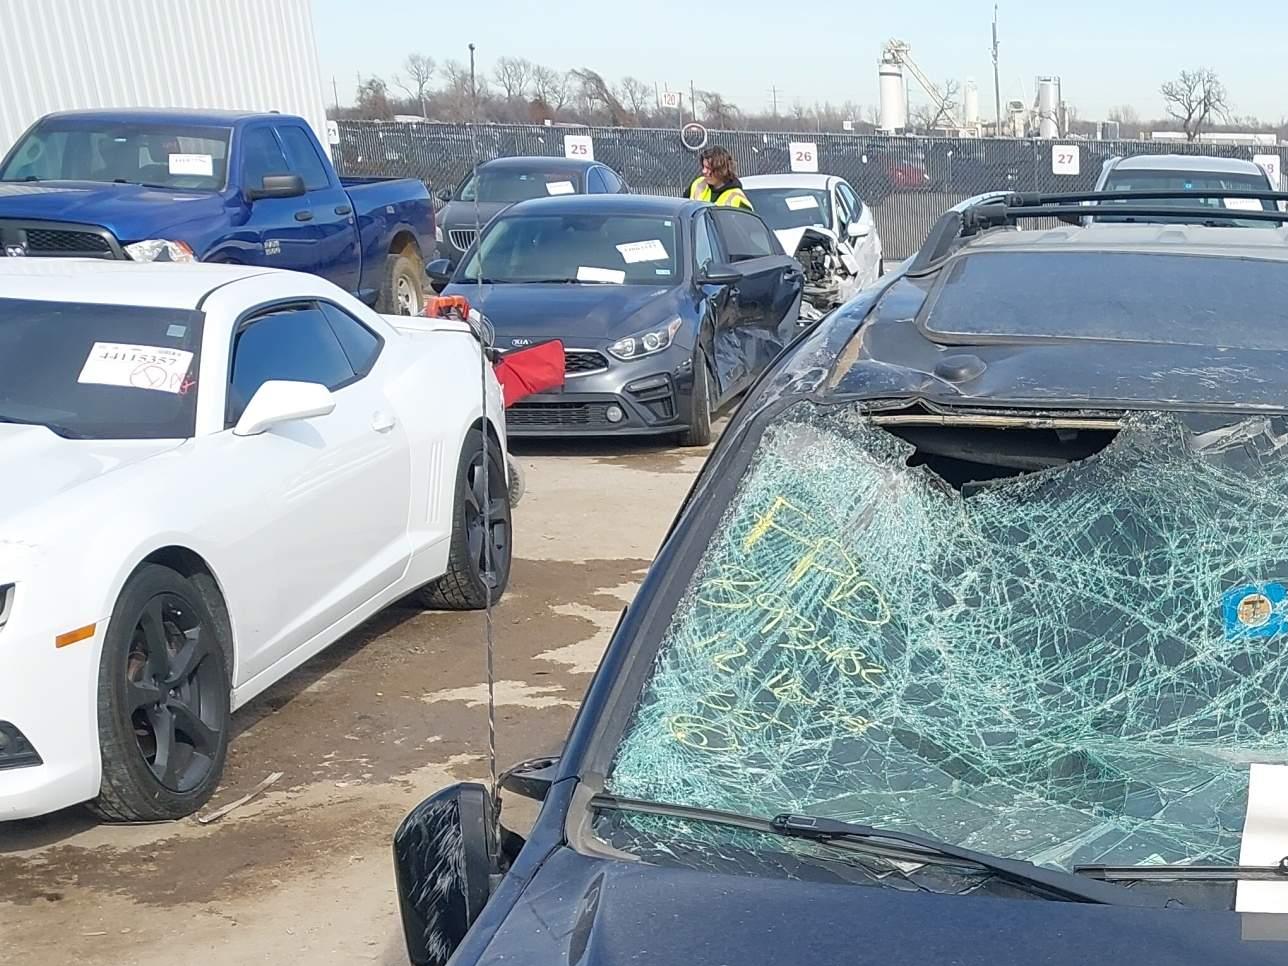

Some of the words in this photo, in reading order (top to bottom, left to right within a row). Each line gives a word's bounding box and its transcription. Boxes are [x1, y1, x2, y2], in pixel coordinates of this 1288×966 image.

[570, 144, 588, 155] 25
[795, 151, 812, 162] 26
[1057, 153, 1073, 164] 27
